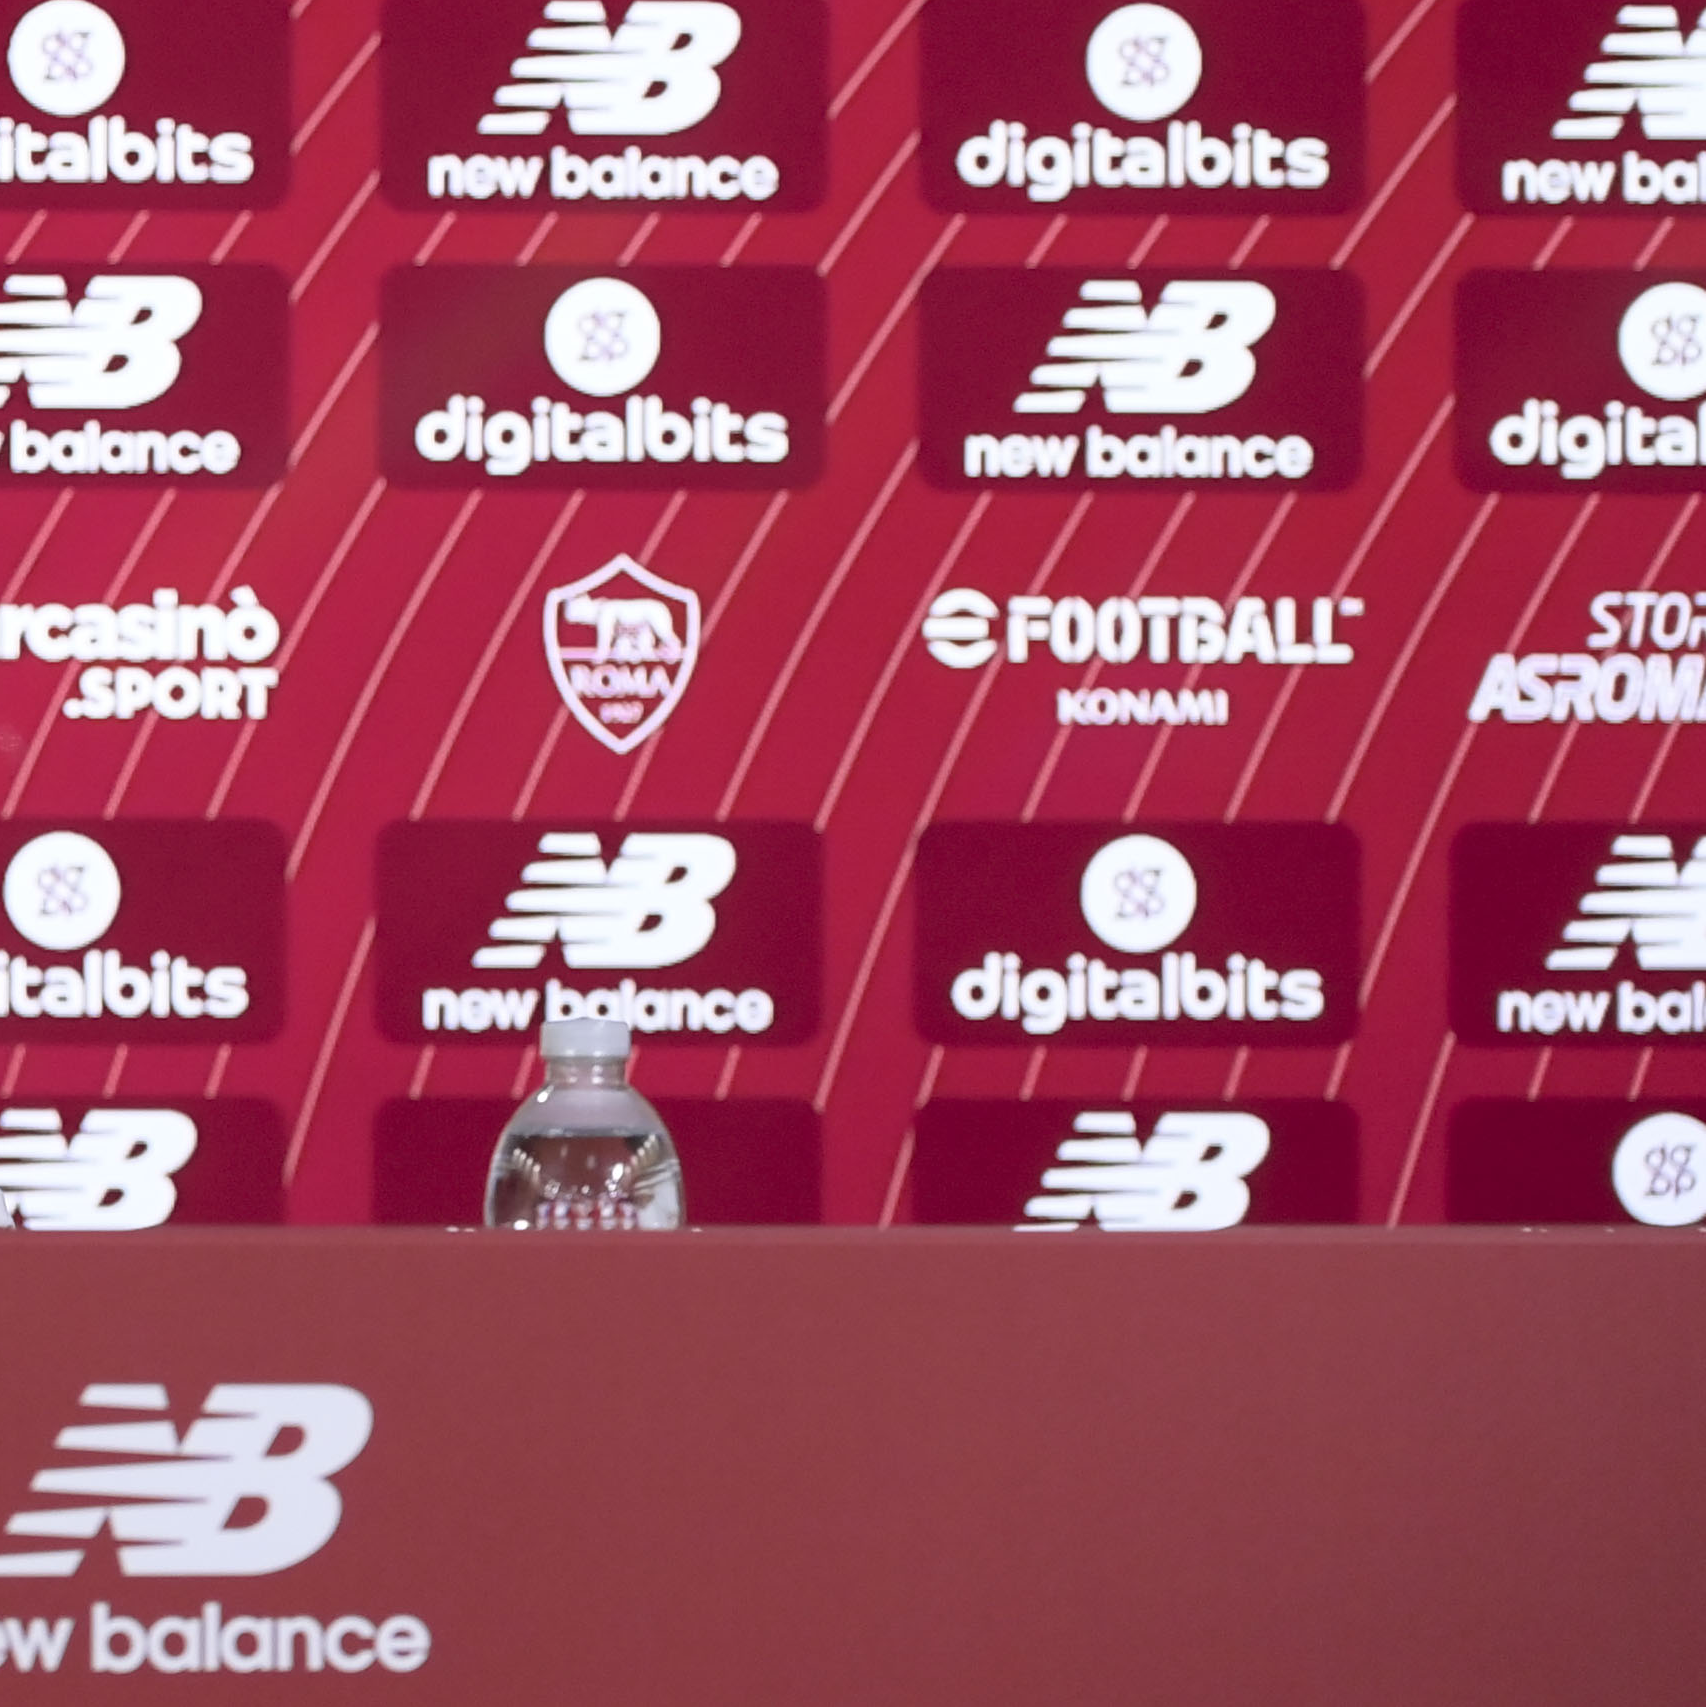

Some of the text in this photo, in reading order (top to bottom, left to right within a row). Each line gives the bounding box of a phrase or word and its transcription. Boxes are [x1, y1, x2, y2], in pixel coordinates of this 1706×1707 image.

[428, 146, 779, 200] new balance
[956, 123, 1329, 201] digitalbits
[10, 420, 240, 474] balance
[415, 398, 788, 475] digitalbits
[964, 425, 1313, 478] new balance
[1057, 687, 1228, 725] KONAMI
[423, 988, 538, 1032] new
[951, 955, 1324, 1034] digitalbits
[90, 1601, 432, 1675] balance
